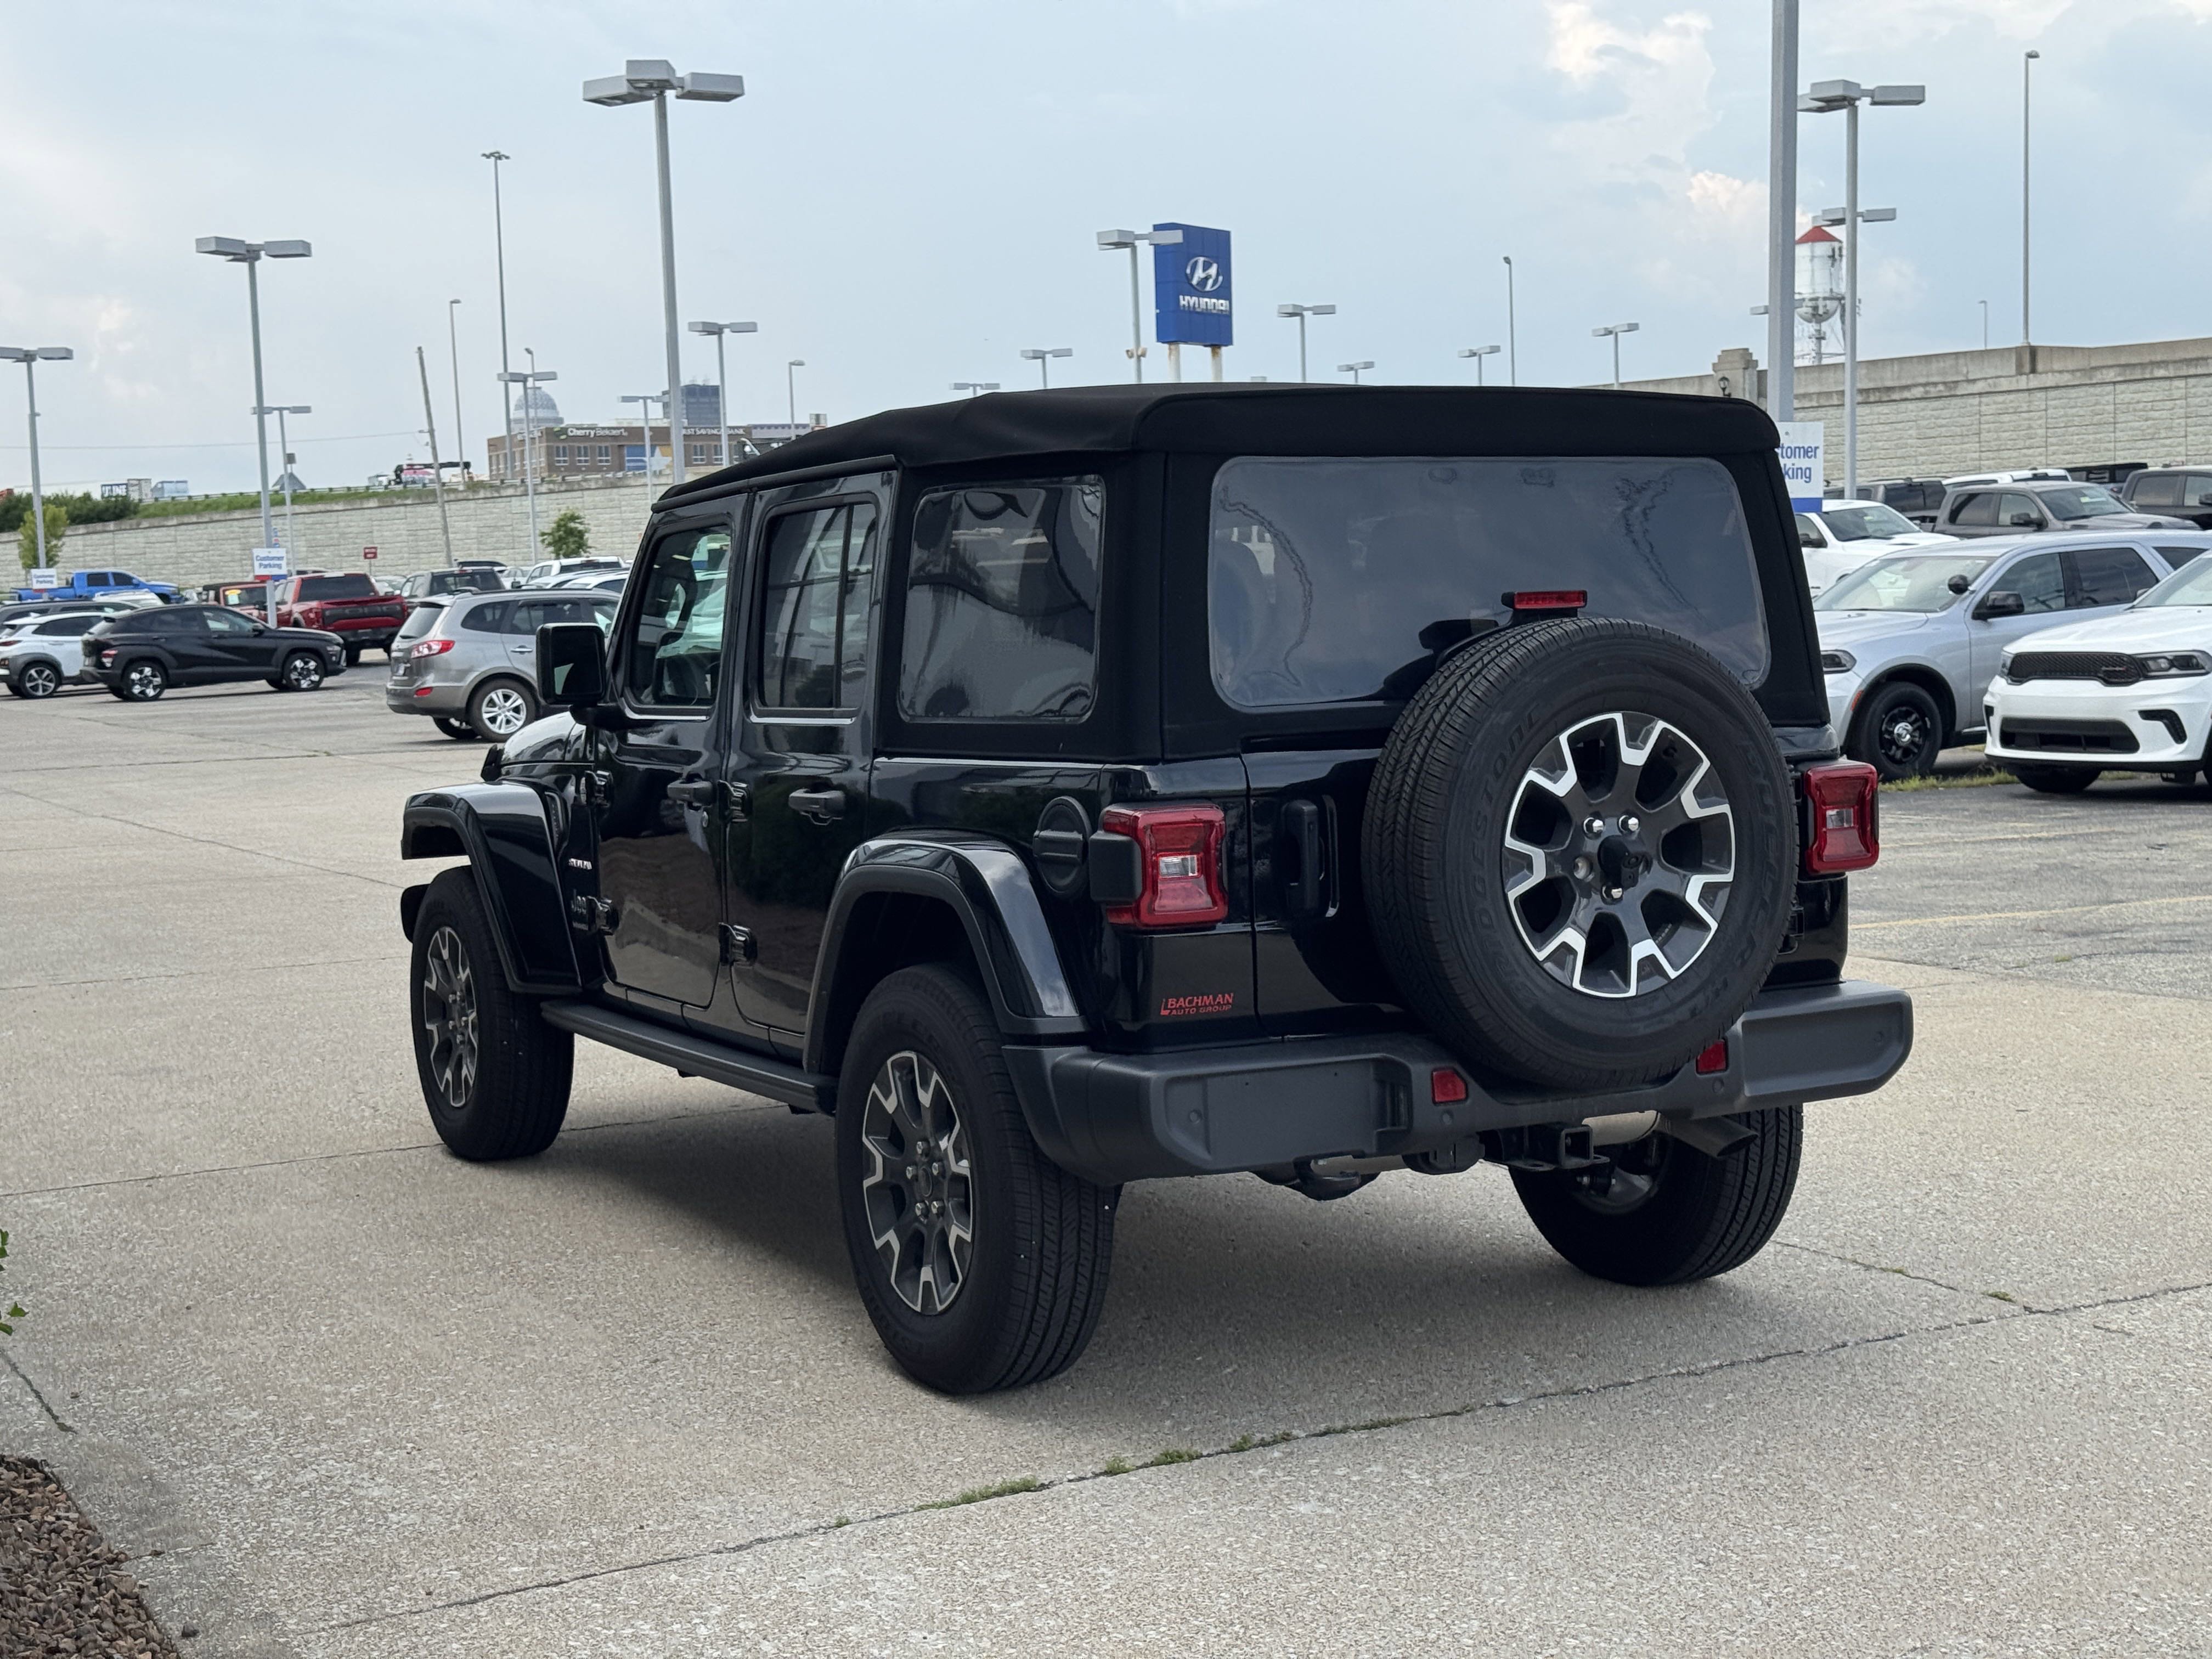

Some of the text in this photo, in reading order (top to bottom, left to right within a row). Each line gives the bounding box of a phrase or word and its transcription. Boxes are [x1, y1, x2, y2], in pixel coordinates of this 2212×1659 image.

[1179, 295, 1229, 311] HYUNDAI
[1778, 443, 1819, 459] tomer
[1784, 463, 1812, 484] king
[1167, 992, 1234, 1009] BACHMAN
